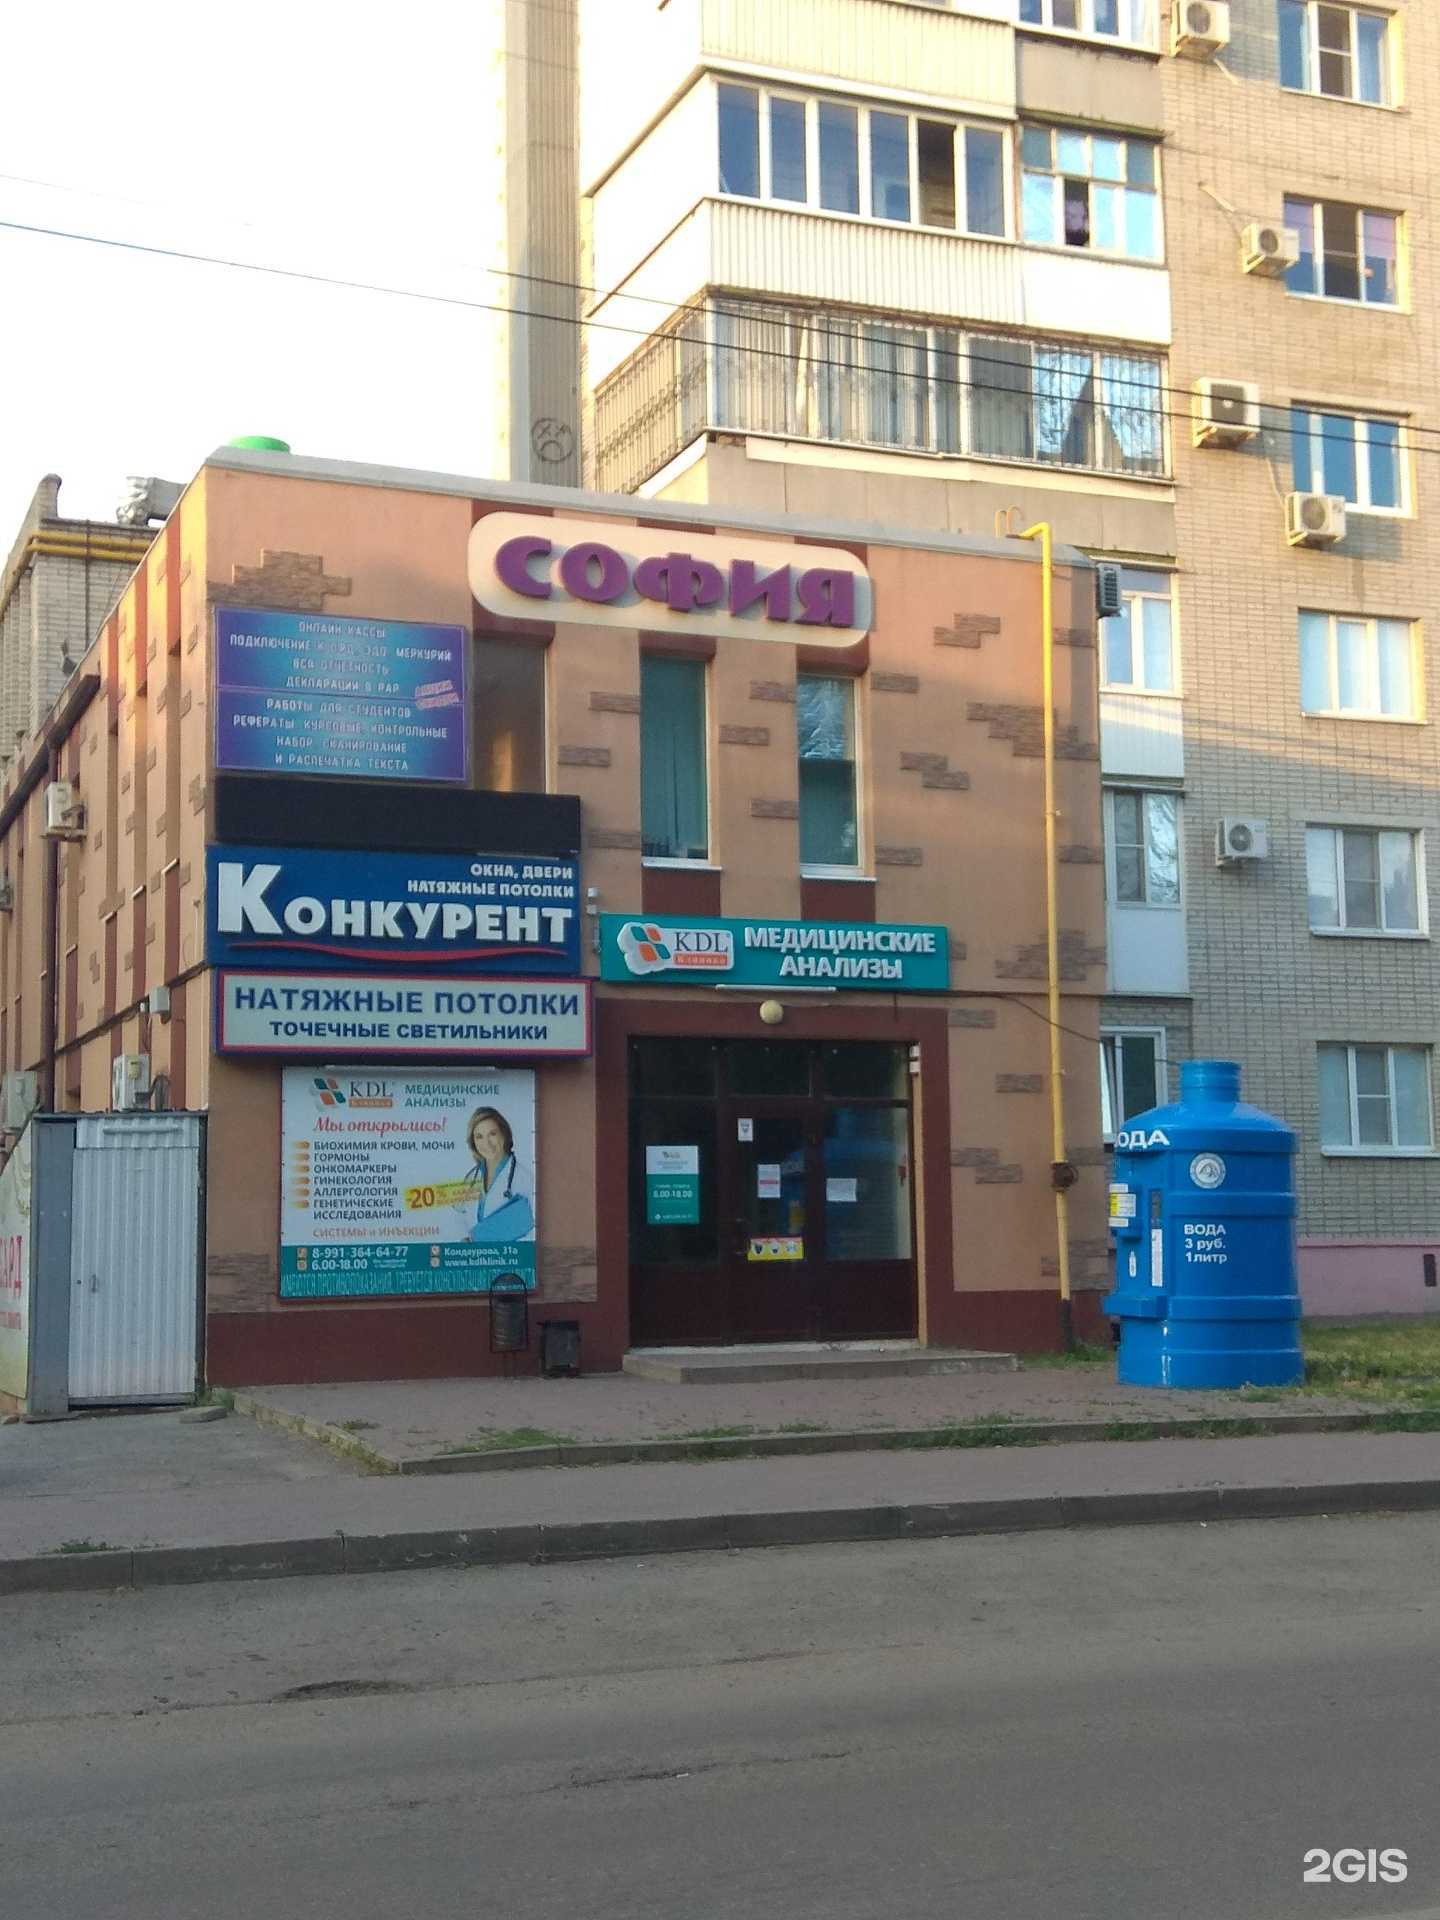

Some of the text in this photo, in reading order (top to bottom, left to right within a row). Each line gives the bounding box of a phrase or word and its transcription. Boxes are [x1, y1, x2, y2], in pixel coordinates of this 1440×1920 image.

[495, 535, 855, 628] СОФИЯ
[229, 633, 311, 651] ПОДКЛЮЧЕНИЕ
[265, 697, 313, 713] РАБОТЫ
[350, 704, 412, 719] СТУДЕНТОВ
[232, 714, 295, 729] РЕФЕРАТЫ
[371, 724, 448, 739] КОНТРОЛЬНЫЕ
[275, 735, 313, 749] НАБОР
[274, 752, 409, 772] И РАСПЕЧАТКА ТЕКСТА
[470, 863, 573, 880] ОКНА, ДВЕРИ
[407, 879, 574, 898] НАТЯЖНЫЕ ПОТОЛКИ
[674, 931, 729, 953] KDL
[744, 926, 936, 955] МЕДИЦИНСКИЕ
[779, 955, 903, 980] АНАЛИЗЫ
[234, 986, 579, 1016] НАТЯЖНЫЕ ПОТОЛКИ
[269, 1020, 549, 1041] ТОЧЕЧНЫЕ СВЕТИЛЬНИКИ
[349, 1080, 394, 1097] KDL
[404, 1084, 500, 1097] МЕДИЦИНСКИЕ
[404, 1097, 466, 1108] АНАЛИЗЫ
[313, 1116, 448, 1138] Мы открылись!
[313, 1140, 378, 1151] БИОХИМИЯ
[421, 1140, 456, 1151] МОЧИ
[1114, 1129, 1170, 1151] ОДА
[313, 1152, 370, 1162] ГОРМОНЫ
[313, 1164, 397, 1174] ОНКОМАРКЕРЫ
[313, 1175, 392, 1185] ГИНЕКОЛОГИЯ
[313, 1187, 399, 1197] АЛЛЕРГОЛОГИЯ
[313, 1198, 393, 1208] ГЕНЕТИЧЕСКИЕ
[313, 1210, 402, 1221] ИССЛЕДОВАНИЯ
[312, 1227, 367, 1238] СИСТЕМЫ
[379, 1225, 440, 1238] ИНЪЕКЦИИ
[1183, 1223, 1227, 1237] ВОДА
[1184, 1237, 1226, 1252] 3 руб.
[311, 1258, 368, 1271] 6.00-18.00
